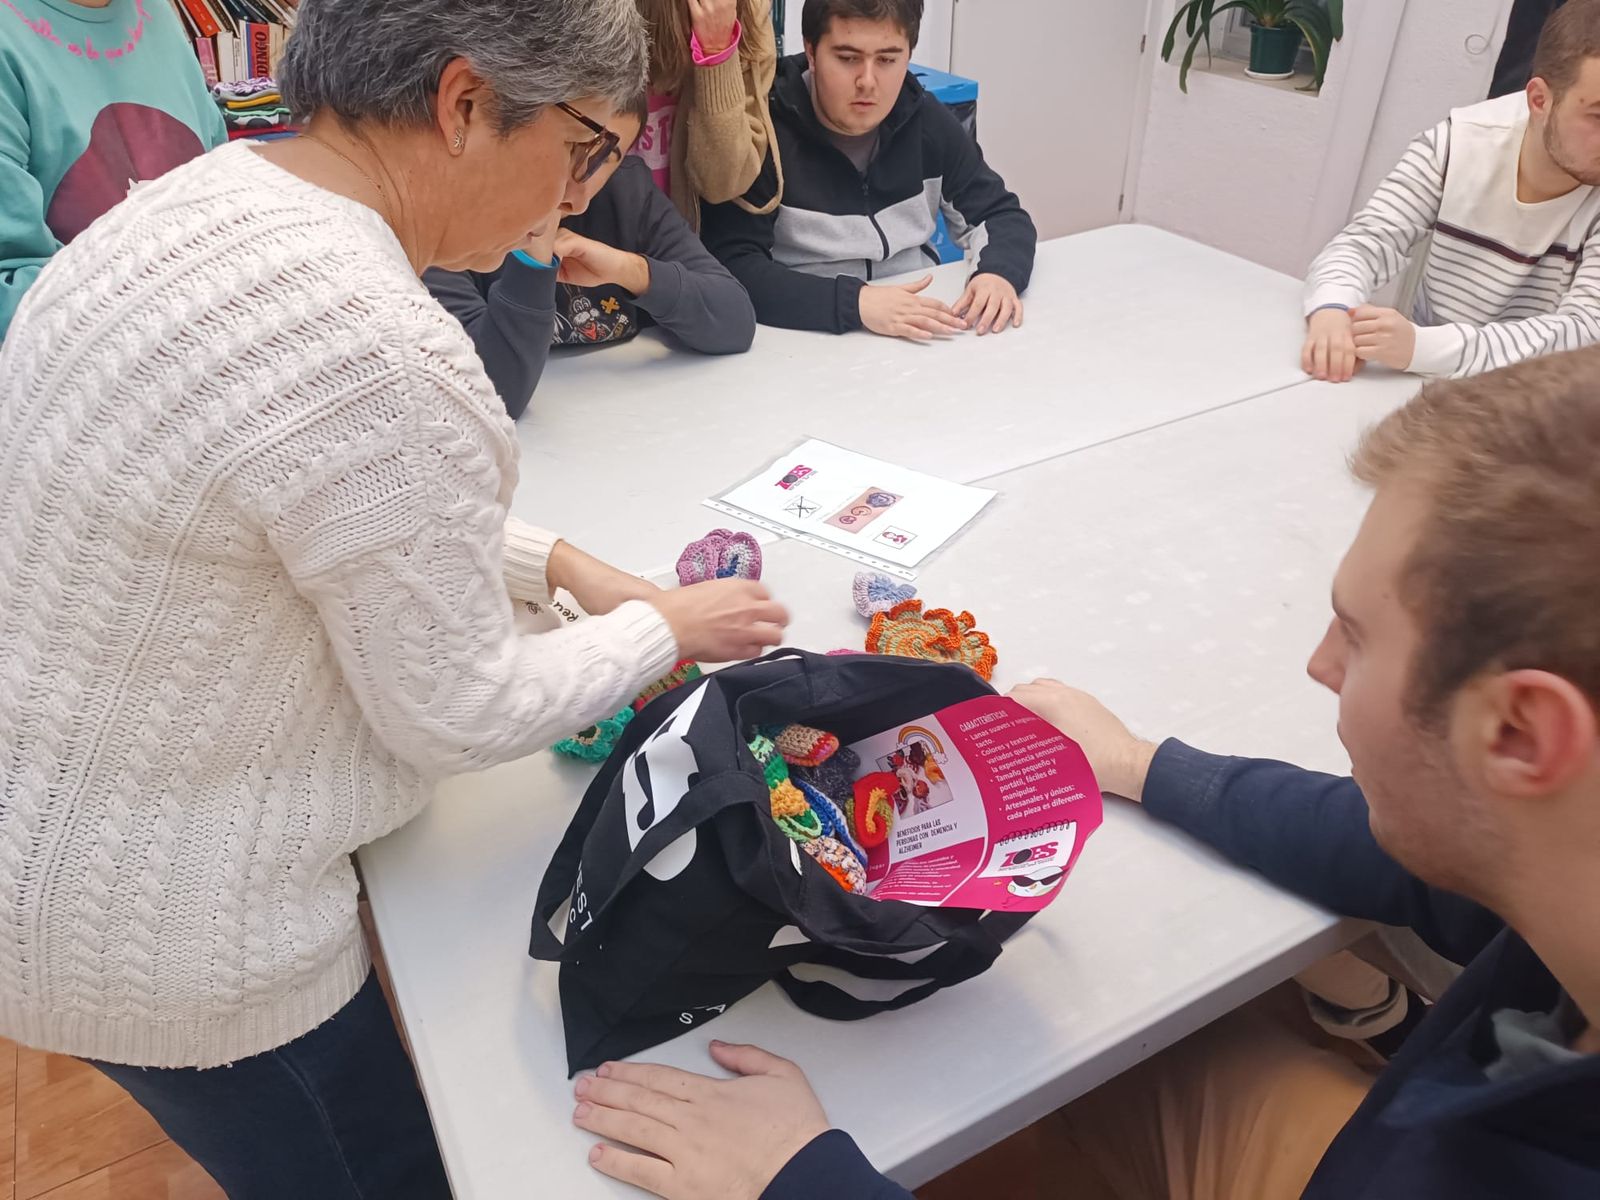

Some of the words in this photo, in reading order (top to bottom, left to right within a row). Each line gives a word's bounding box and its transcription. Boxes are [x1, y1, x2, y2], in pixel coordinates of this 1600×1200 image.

[969, 730, 989, 740] Lanas
[989, 722, 1010, 733] suaves
[981, 744, 1005, 756] Colores
[1010, 733, 1037, 746] texturas
[987, 751, 1013, 764] variados
[1014, 747, 1027, 756] que
[999, 754, 1035, 771] experiencia
[1035, 743, 1067, 758] sensorial.
[995, 769, 1021, 782] Tamaño
[1022, 760, 1051, 774] pequeño
[1000, 778, 1026, 793] portátil,
[1026, 771, 1048, 784] fáciles
[1048, 768, 1057, 776] de
[1002, 786, 1037, 801] manipular.
[1005, 794, 1044, 811] Artesanales
[1050, 784, 1076, 797] únicos:
[1007, 812, 1023, 821] cada
[1024, 806, 1041, 818] pieza
[1051, 792, 1086, 807] diferente.
[919, 831, 929, 841] CON
[921, 822, 932, 832] PARA
[932, 819, 941, 828] LAS
